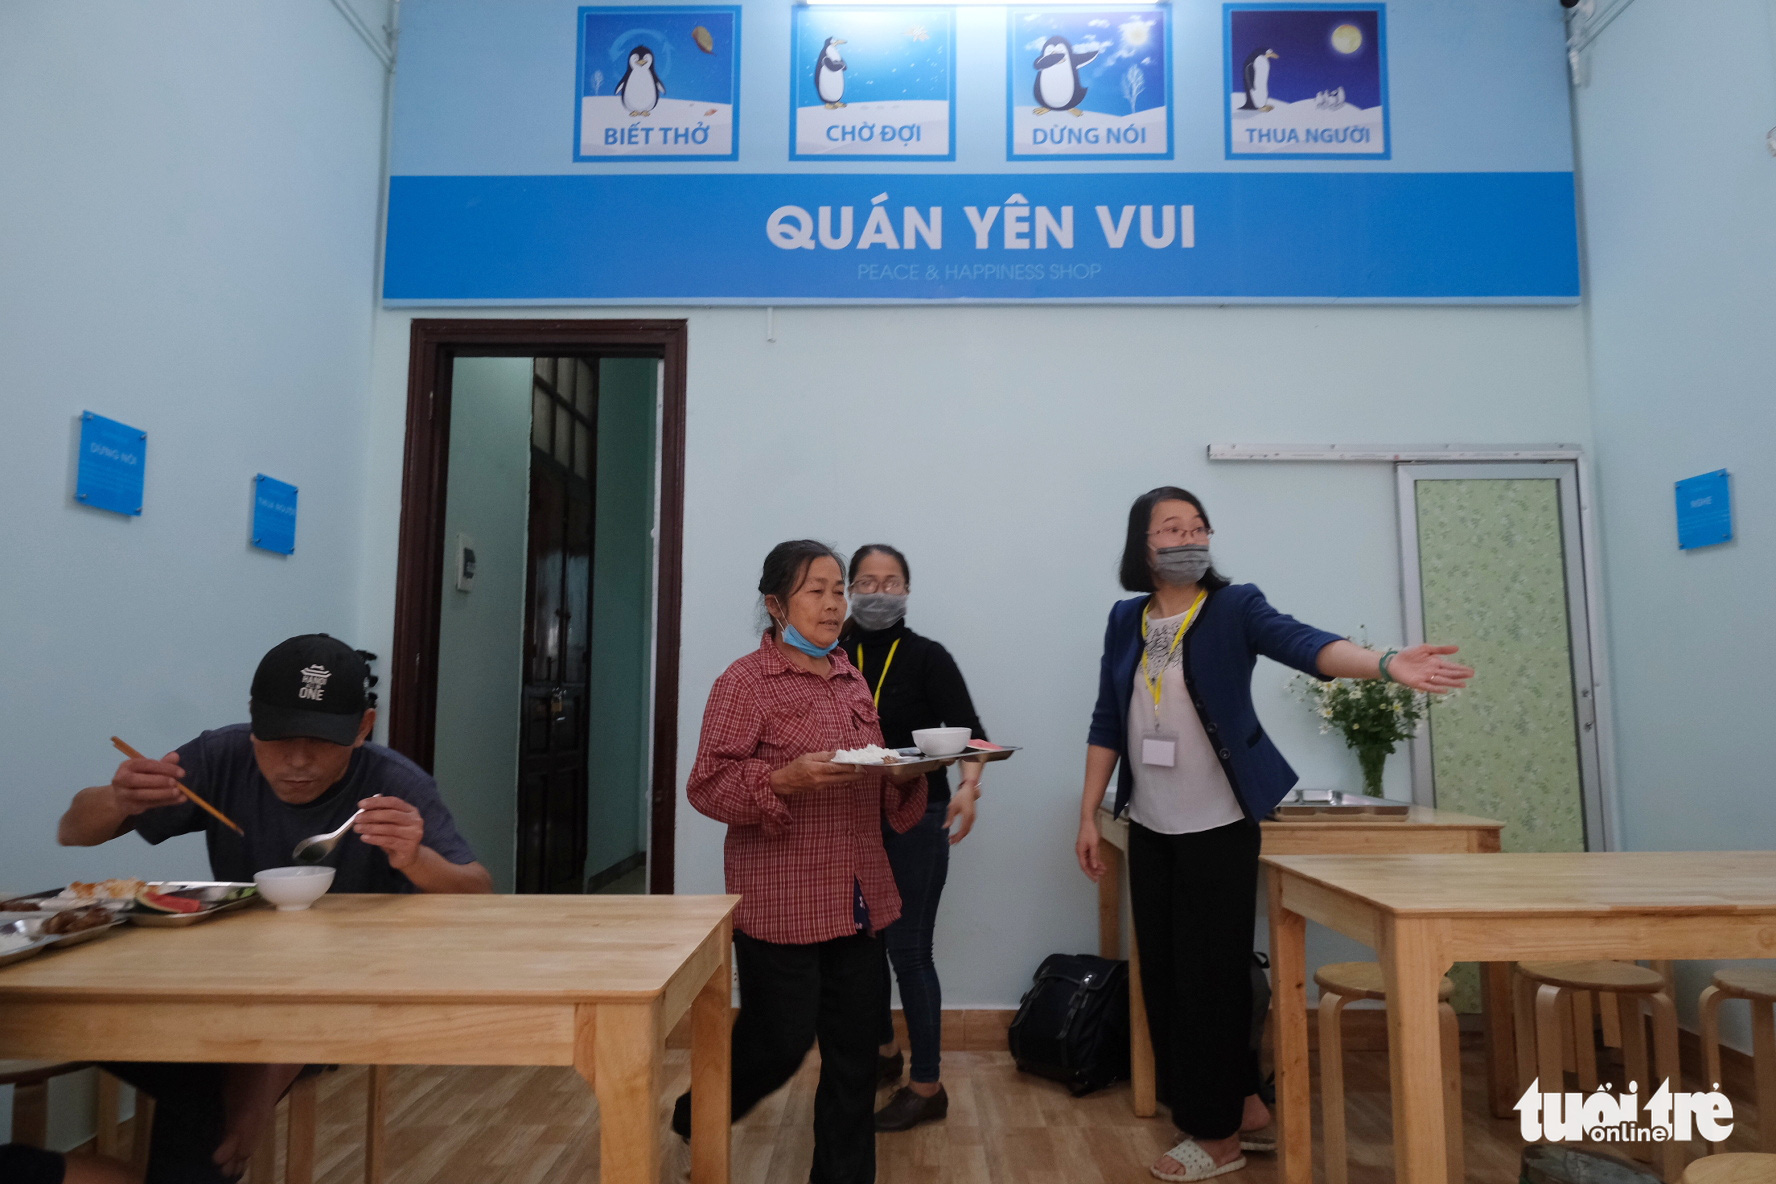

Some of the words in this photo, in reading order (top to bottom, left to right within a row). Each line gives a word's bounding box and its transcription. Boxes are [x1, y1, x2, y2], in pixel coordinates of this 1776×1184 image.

[604, 121, 655, 145] BIẾT
[658, 121, 711, 145] THỞ
[826, 121, 876, 142] CHỜ
[879, 123, 921, 147] ĐỢI
[1032, 124, 1099, 145] DỪNG
[1105, 123, 1146, 144] NÓI
[1245, 127, 1300, 144] THUA
[1305, 125, 1371, 144] NGƯỜI
[765, 191, 942, 251] QUÁN
[963, 192, 1074, 251] YÊN
[1094, 203, 1196, 250] VUI
[857, 264, 920, 281] PEACE
[925, 264, 940, 281] &
[944, 263, 1046, 281] HAPPINESS
[1048, 263, 1103, 280] SHOP
[298, 686, 325, 701] ONE
